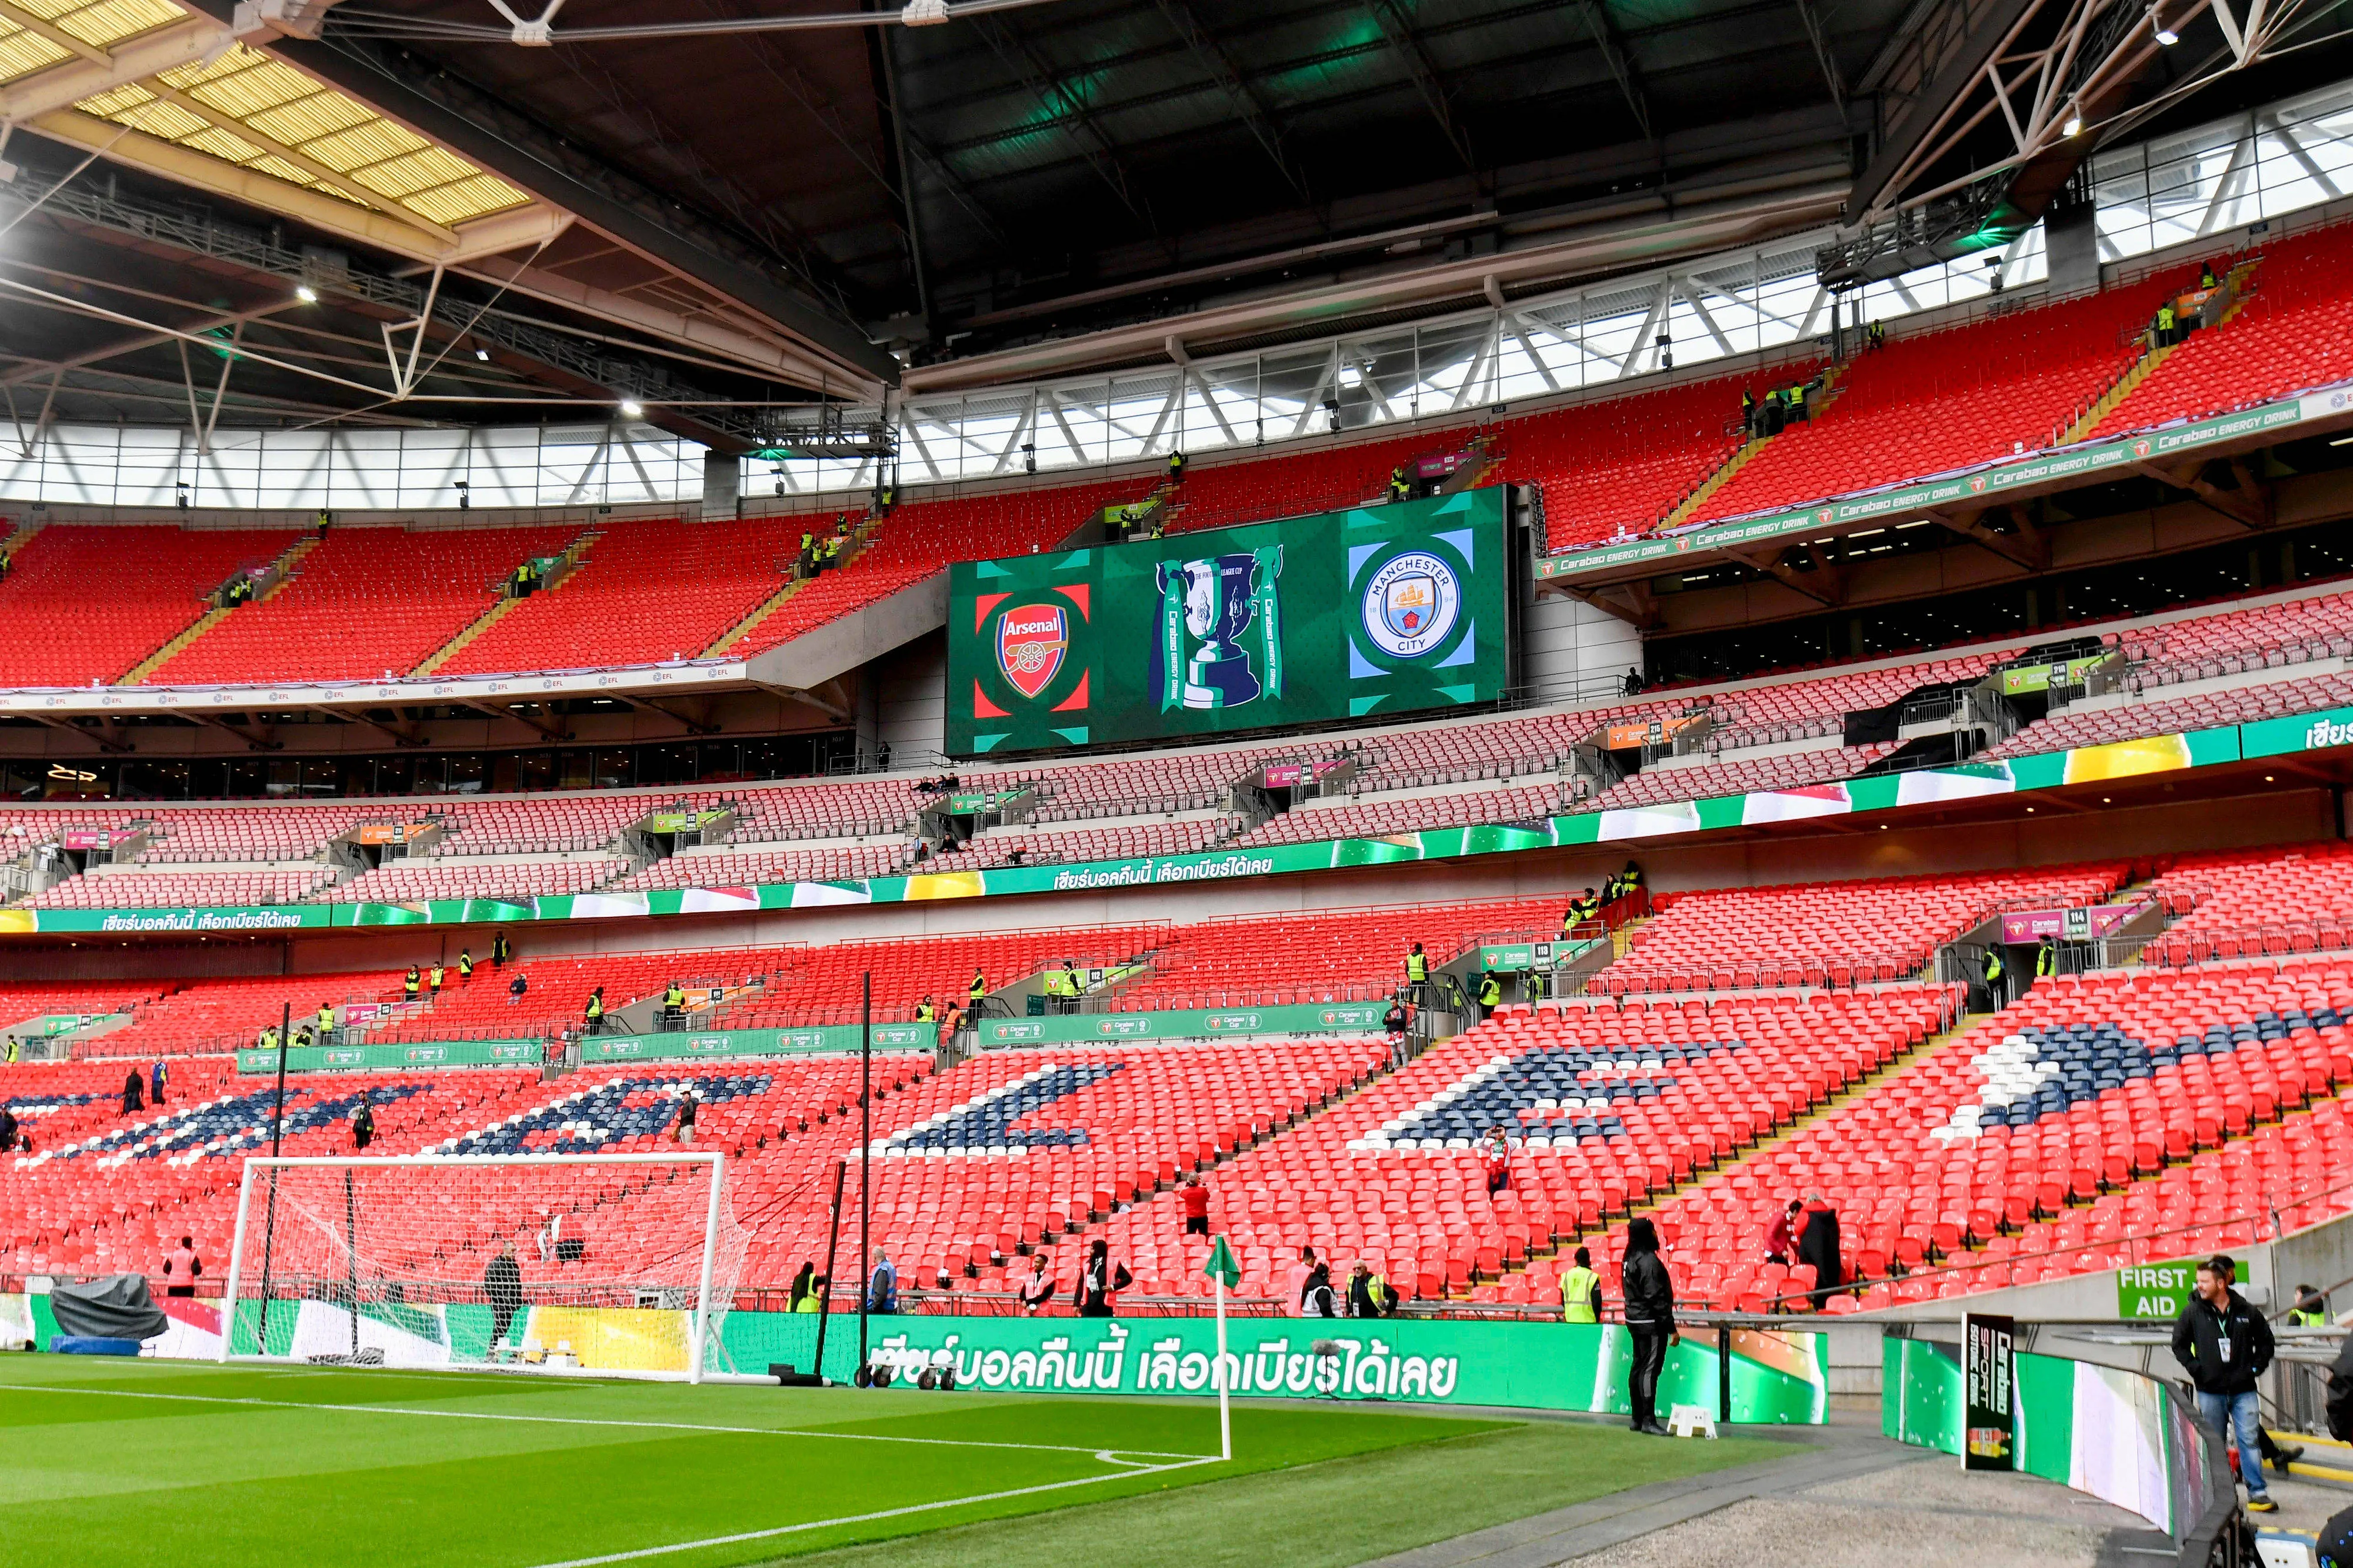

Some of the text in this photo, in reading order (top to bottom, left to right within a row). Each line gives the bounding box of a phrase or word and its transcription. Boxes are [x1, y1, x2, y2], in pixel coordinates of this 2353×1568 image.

[2158, 408, 2297, 449] Carabao ENERGY DRINK
[1994, 449, 2123, 485] Carabao ENERGY DRINK
[1840, 485, 1961, 517] Carabao ENERGY DRINK
[1697, 516, 1809, 545] Carabao ENERGY DRINK
[1561, 543, 1668, 570] Carabao ENERGY DRINK
[1221, 568, 1235, 576] LEAGUE
[1372, 559, 1449, 595] MANCHESTER
[1005, 617, 1058, 636] Arsenal
[1169, 611, 1178, 651] Carabao
[1265, 599, 1274, 639] Carabao
[1268, 641, 1276, 668] ENERGY
[1398, 639, 1426, 651] CITY
[2070, 912, 2085, 923] 114
[1537, 945, 1548, 955] 113
[1091, 971, 1101, 980] 112
[2120, 1268, 2187, 1289] FIRST
[2135, 1296, 2175, 1316] AID
[1981, 1327, 1989, 1409] SPORT
[1997, 1330, 2011, 1416] Carabao
